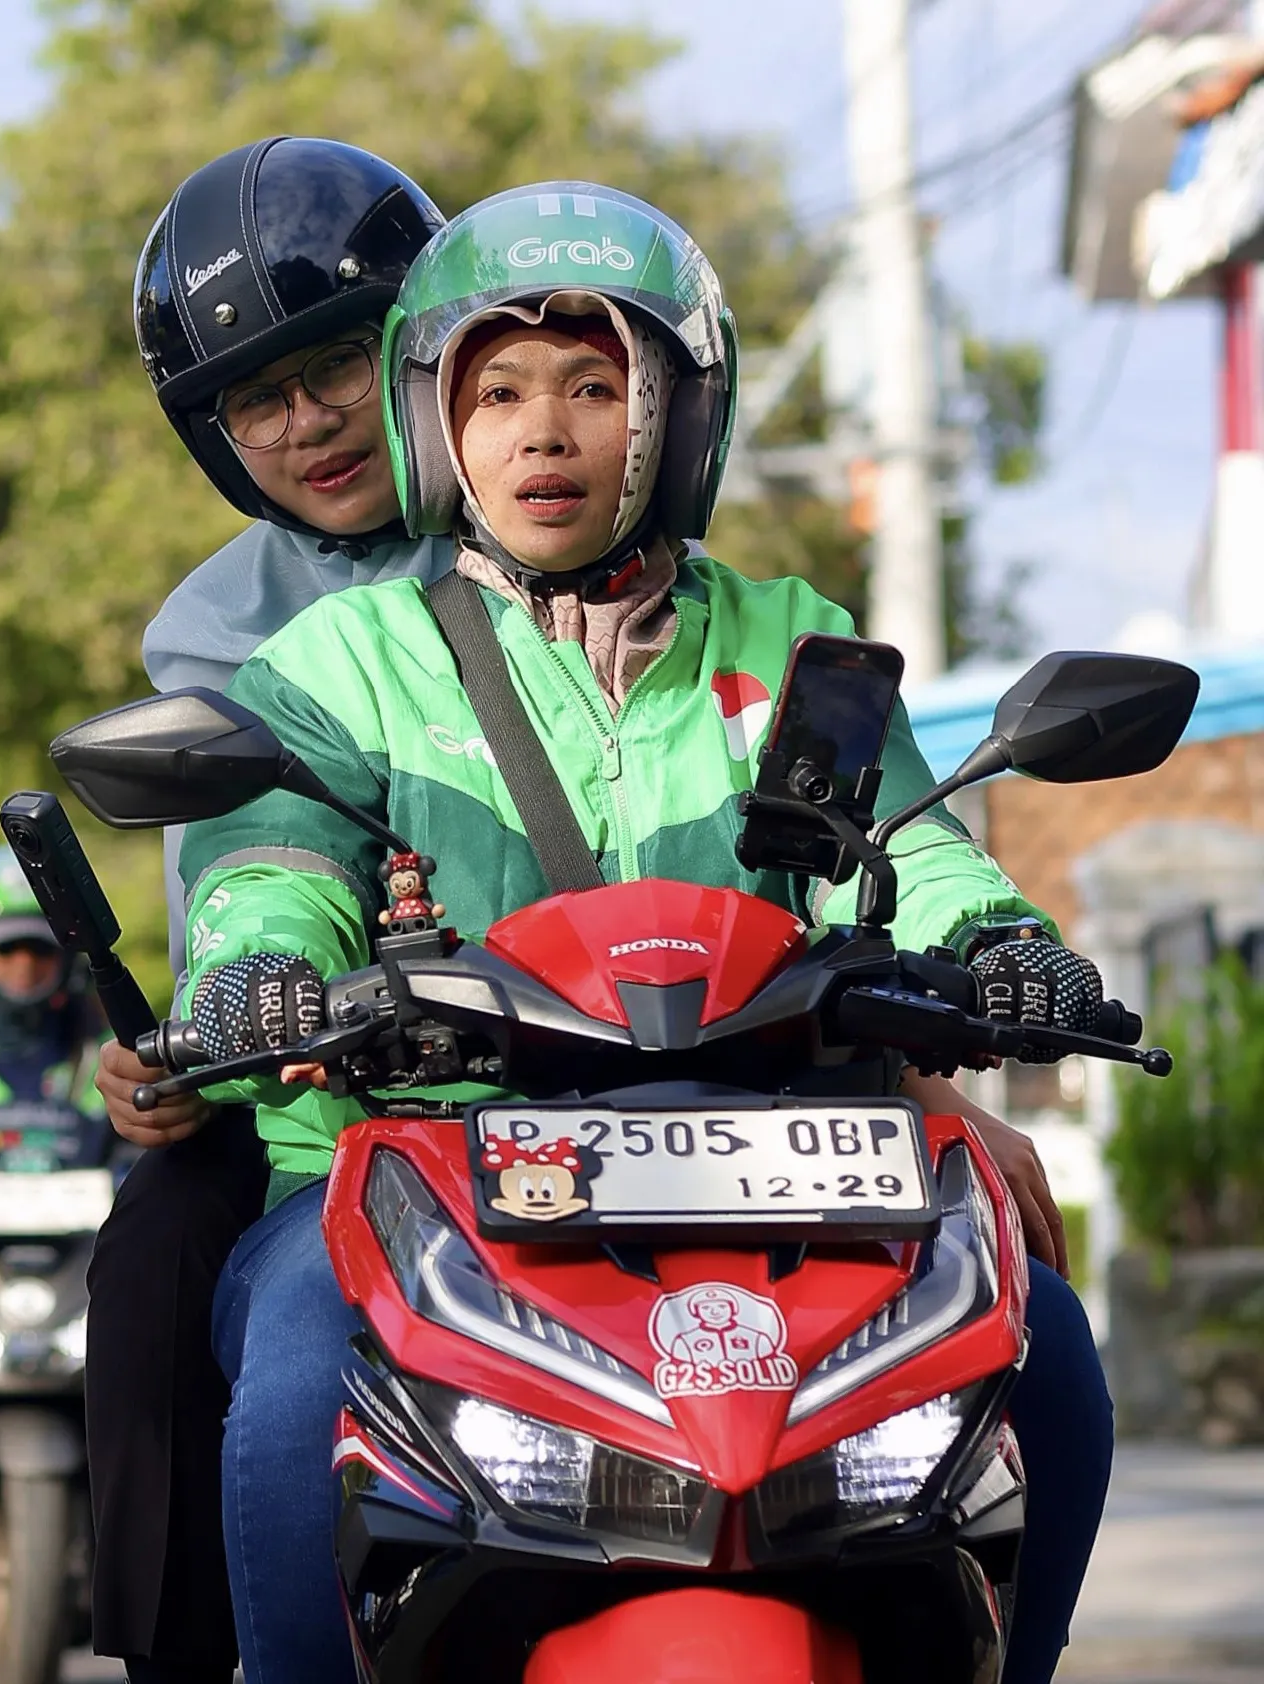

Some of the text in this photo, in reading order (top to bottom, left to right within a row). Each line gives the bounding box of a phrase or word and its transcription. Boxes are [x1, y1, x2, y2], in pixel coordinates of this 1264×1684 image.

[507, 235, 634, 271] Grab
[185, 248, 243, 297] Vespa
[609, 938, 709, 958] HONDA
